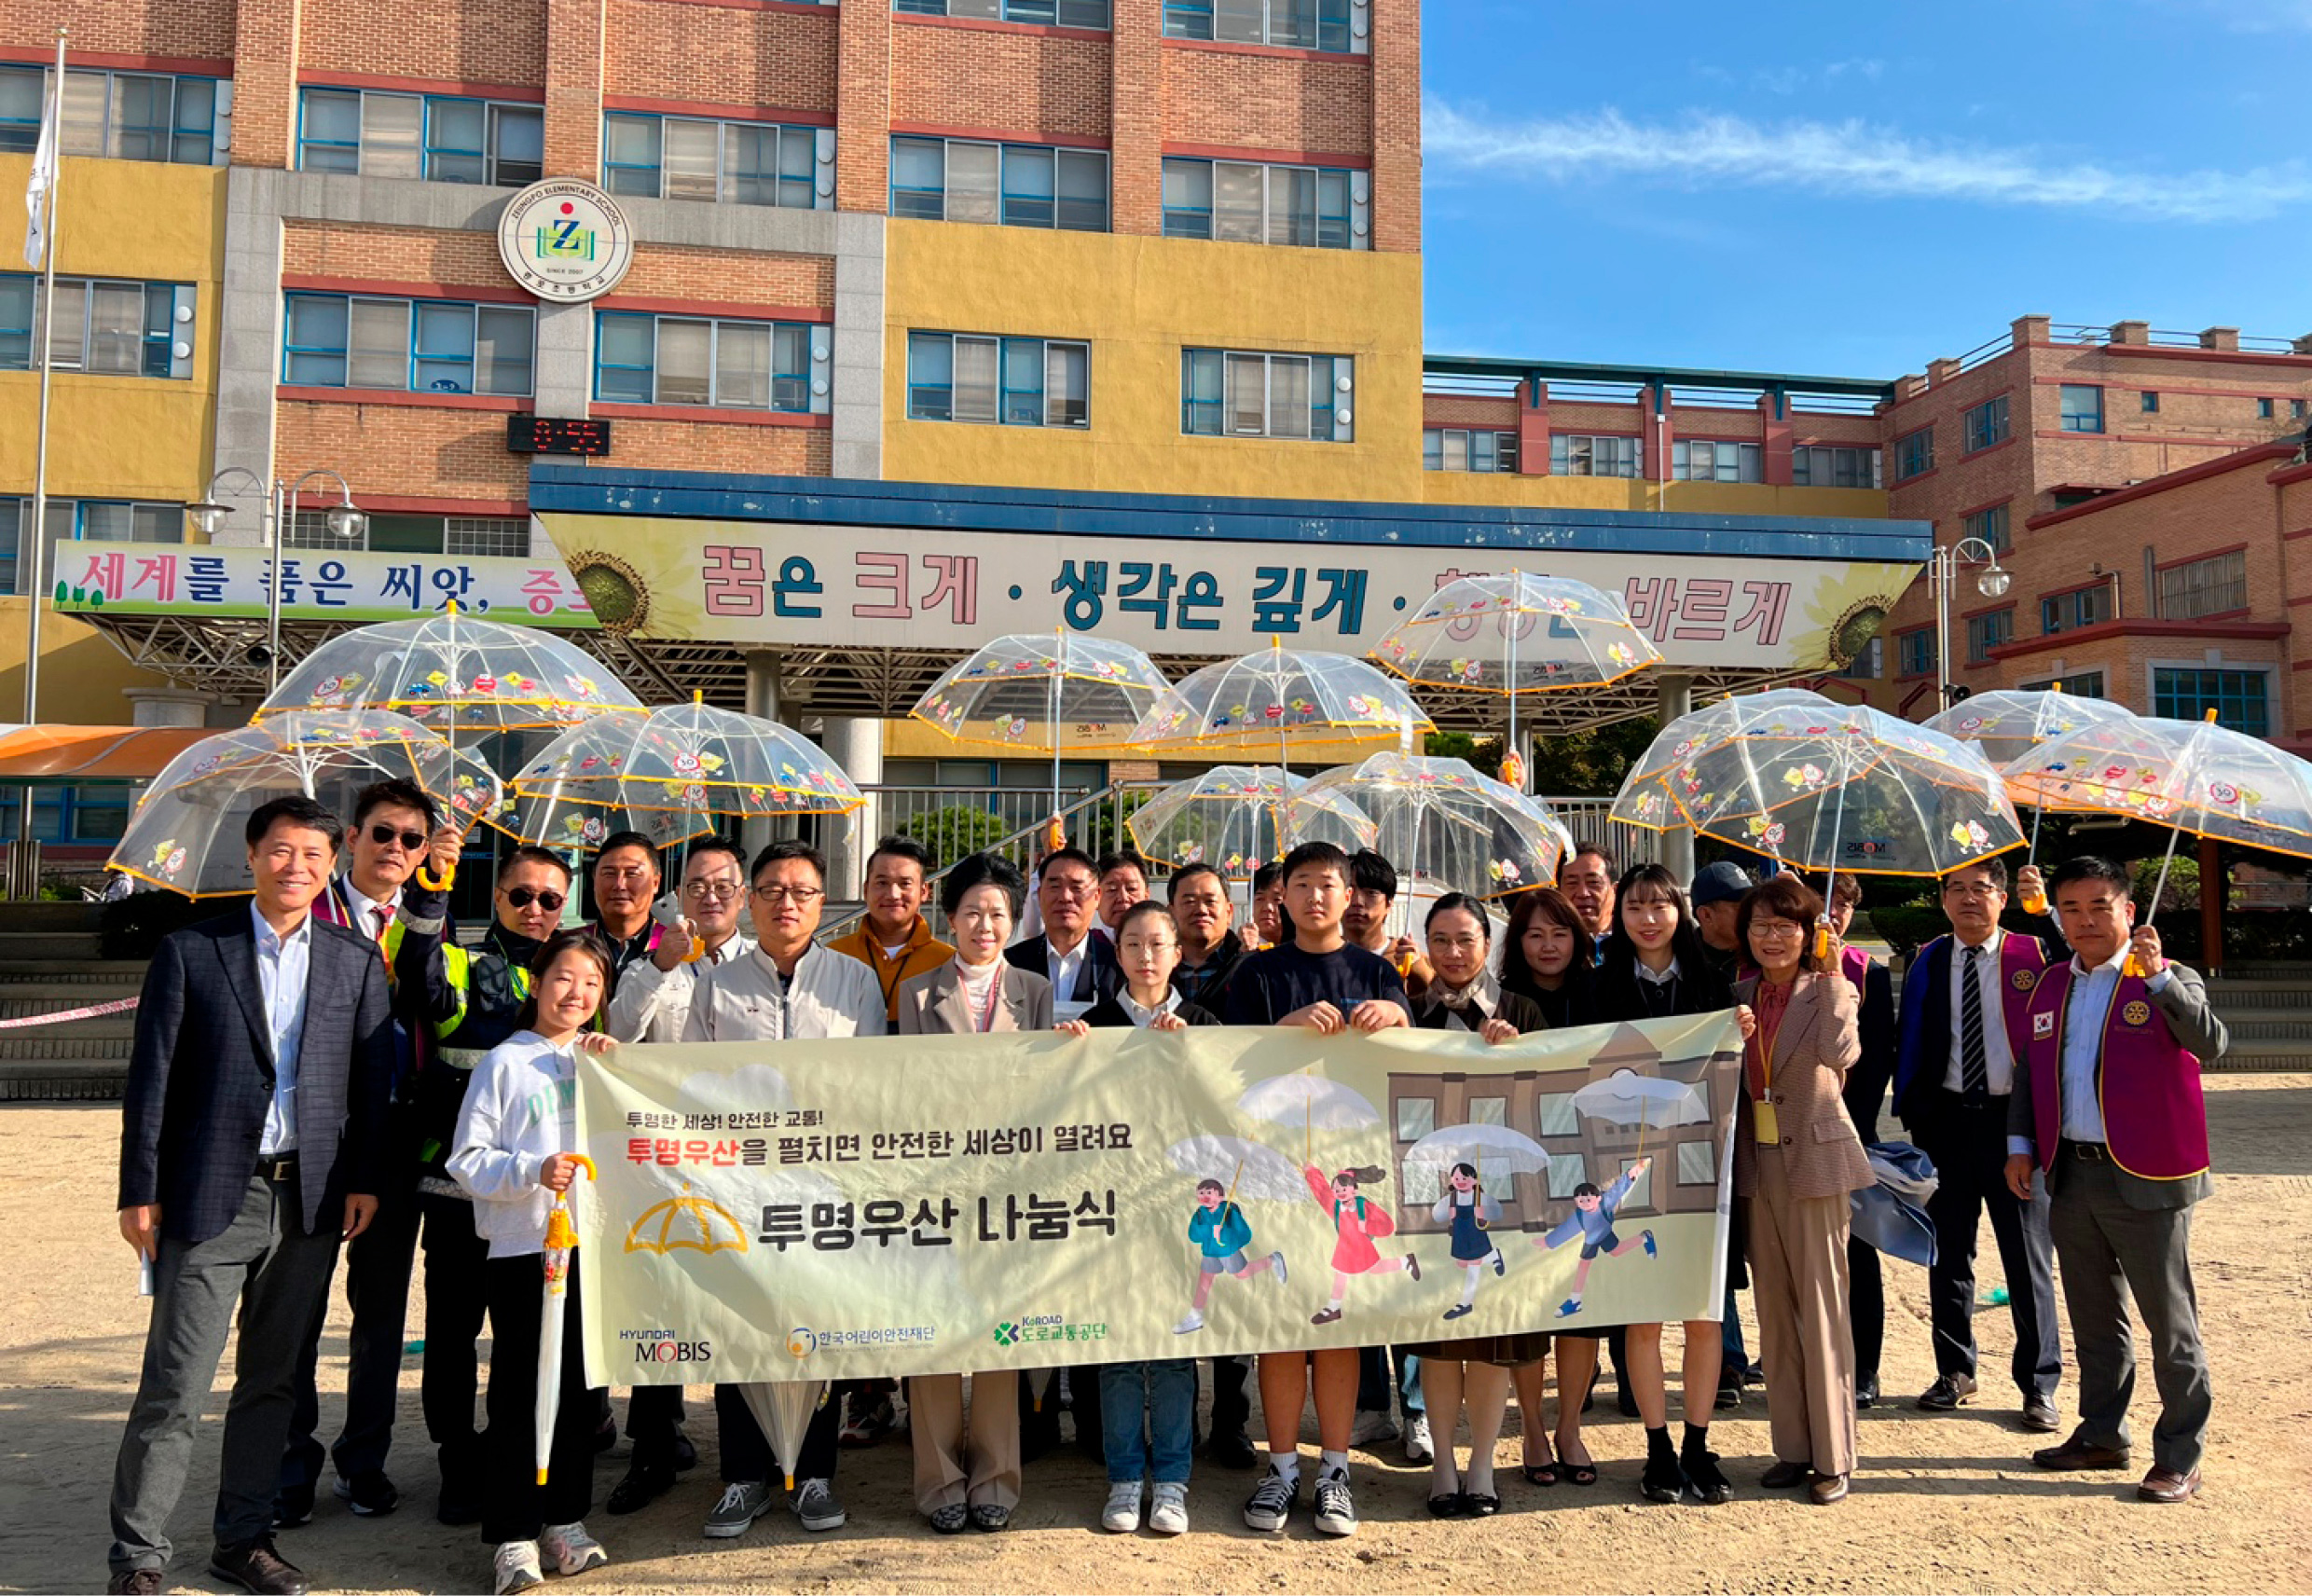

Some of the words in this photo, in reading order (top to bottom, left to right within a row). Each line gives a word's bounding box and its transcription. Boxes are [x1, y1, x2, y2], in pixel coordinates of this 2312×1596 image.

[544, 185, 597, 200] ELEMENTARY
[595, 197, 622, 227] SCHOOL
[552, 220, 580, 249] Z
[79, 553, 230, 602] 세계를
[258, 559, 354, 606] 품은
[379, 564, 489, 613] 씨앗,
[702, 545, 823, 619] 꿈은
[852, 552, 979, 626] 크게
[1051, 559, 1224, 631] 생각은
[1252, 566, 1369, 636] 깊게
[1623, 576, 1793, 646] 바르게
[626, 1111, 678, 1130] 투명한
[682, 1113, 722, 1131] 세상!
[728, 1111, 779, 1130] 안전한
[785, 1110, 824, 1128] 교통!
[626, 1137, 768, 1167] 투명우산을
[778, 1134, 860, 1164] 펼치면
[872, 1130, 955, 1161] 안전한
[962, 1126, 1043, 1156] 세상이
[1053, 1122, 1133, 1152] 열려요
[757, 1196, 959, 1253] 투명우산
[977, 1189, 1116, 1242] 나눔식
[620, 1329, 675, 1340] HYUNDAI
[819, 1325, 936, 1346] 한국어린이안전재단
[1021, 1322, 1108, 1343] 도로교통공단
[635, 1341, 712, 1364] MOBIS
